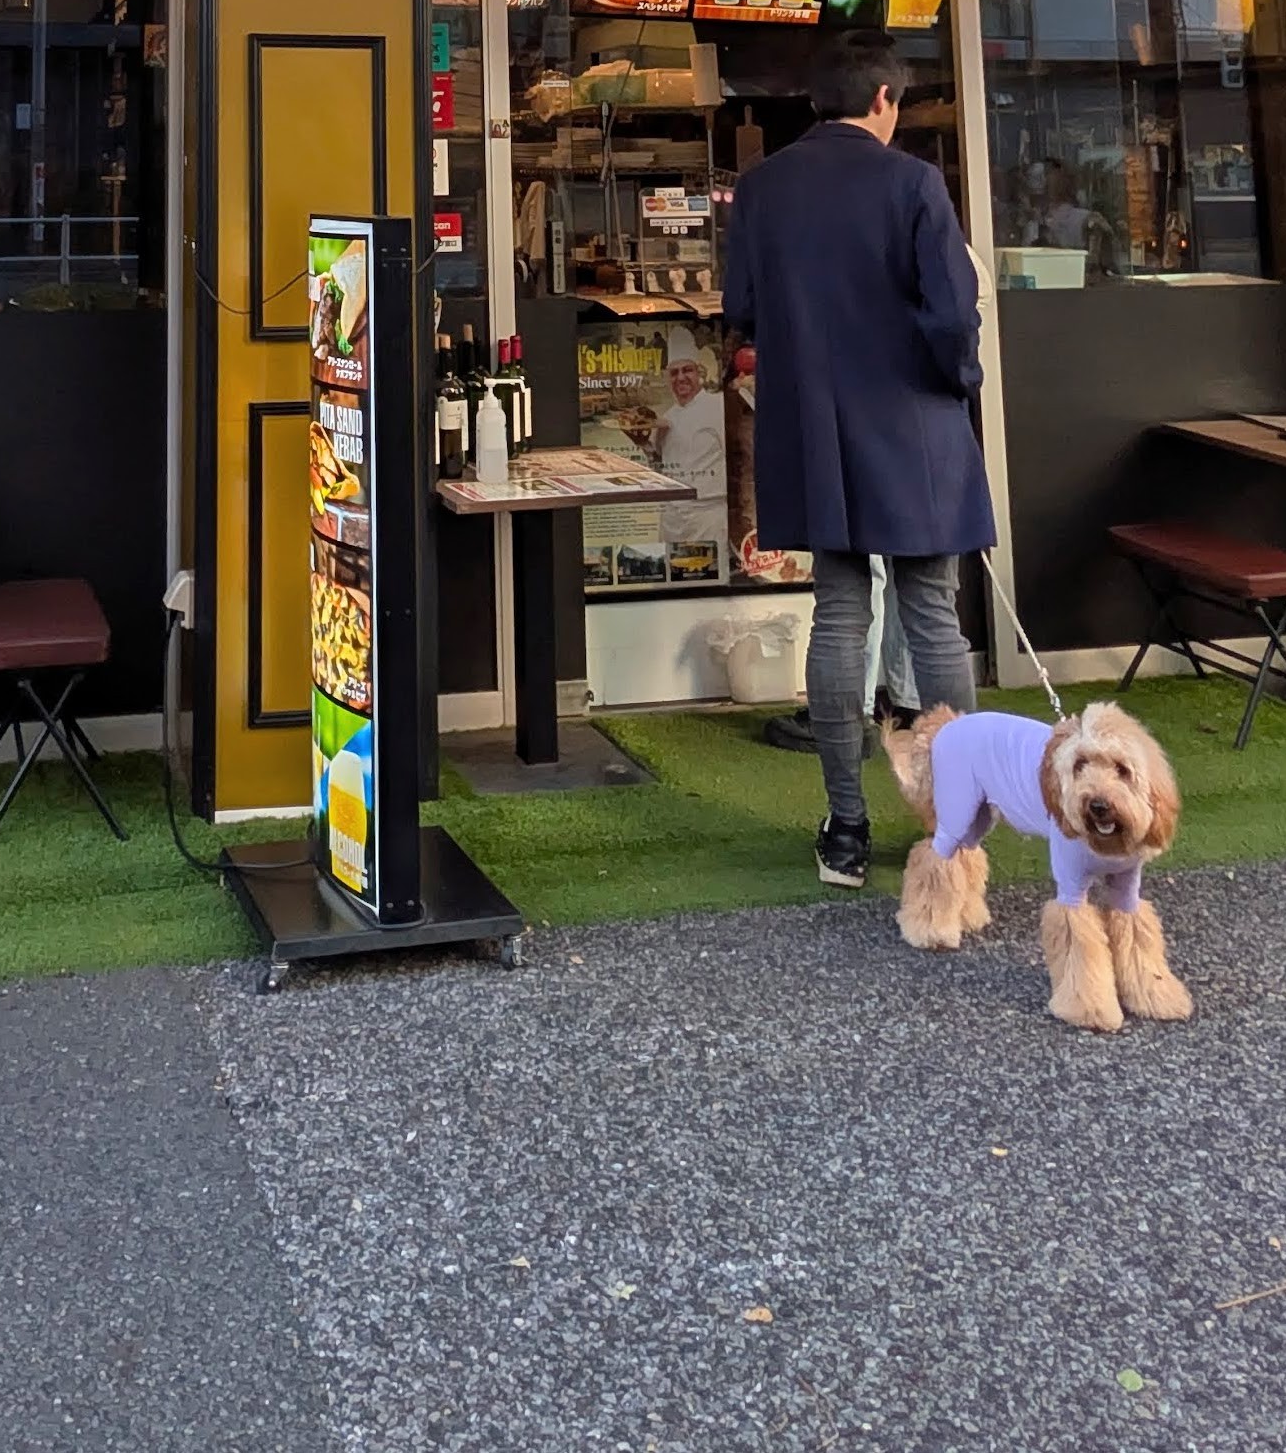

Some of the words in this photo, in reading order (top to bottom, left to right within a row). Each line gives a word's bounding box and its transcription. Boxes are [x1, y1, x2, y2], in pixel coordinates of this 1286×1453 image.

[579, 377, 612, 389] Since
[615, 375, 644, 388] 1997
[336, 406, 363, 437] SAND
[333, 432, 364, 464] KEBAB
